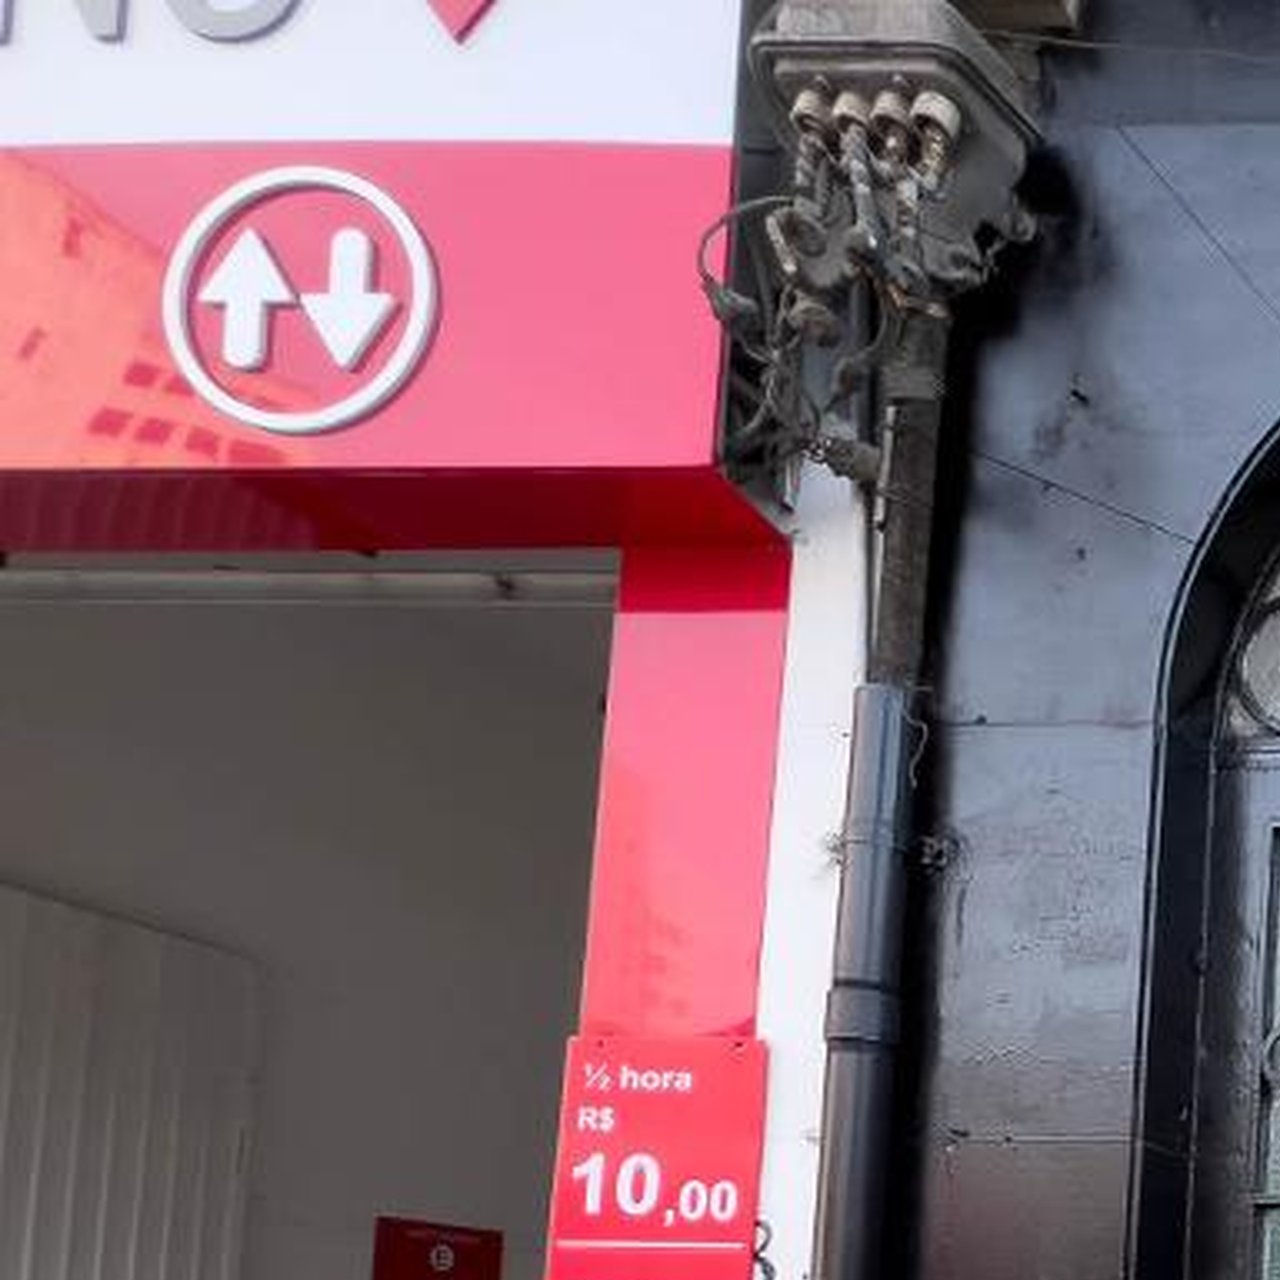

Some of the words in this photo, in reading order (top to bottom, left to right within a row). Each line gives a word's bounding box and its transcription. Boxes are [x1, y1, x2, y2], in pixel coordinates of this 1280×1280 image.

[620, 1064, 693, 1092] hora
[577, 1107, 615, 1132] R$
[571, 1153, 739, 1226] 10,00
